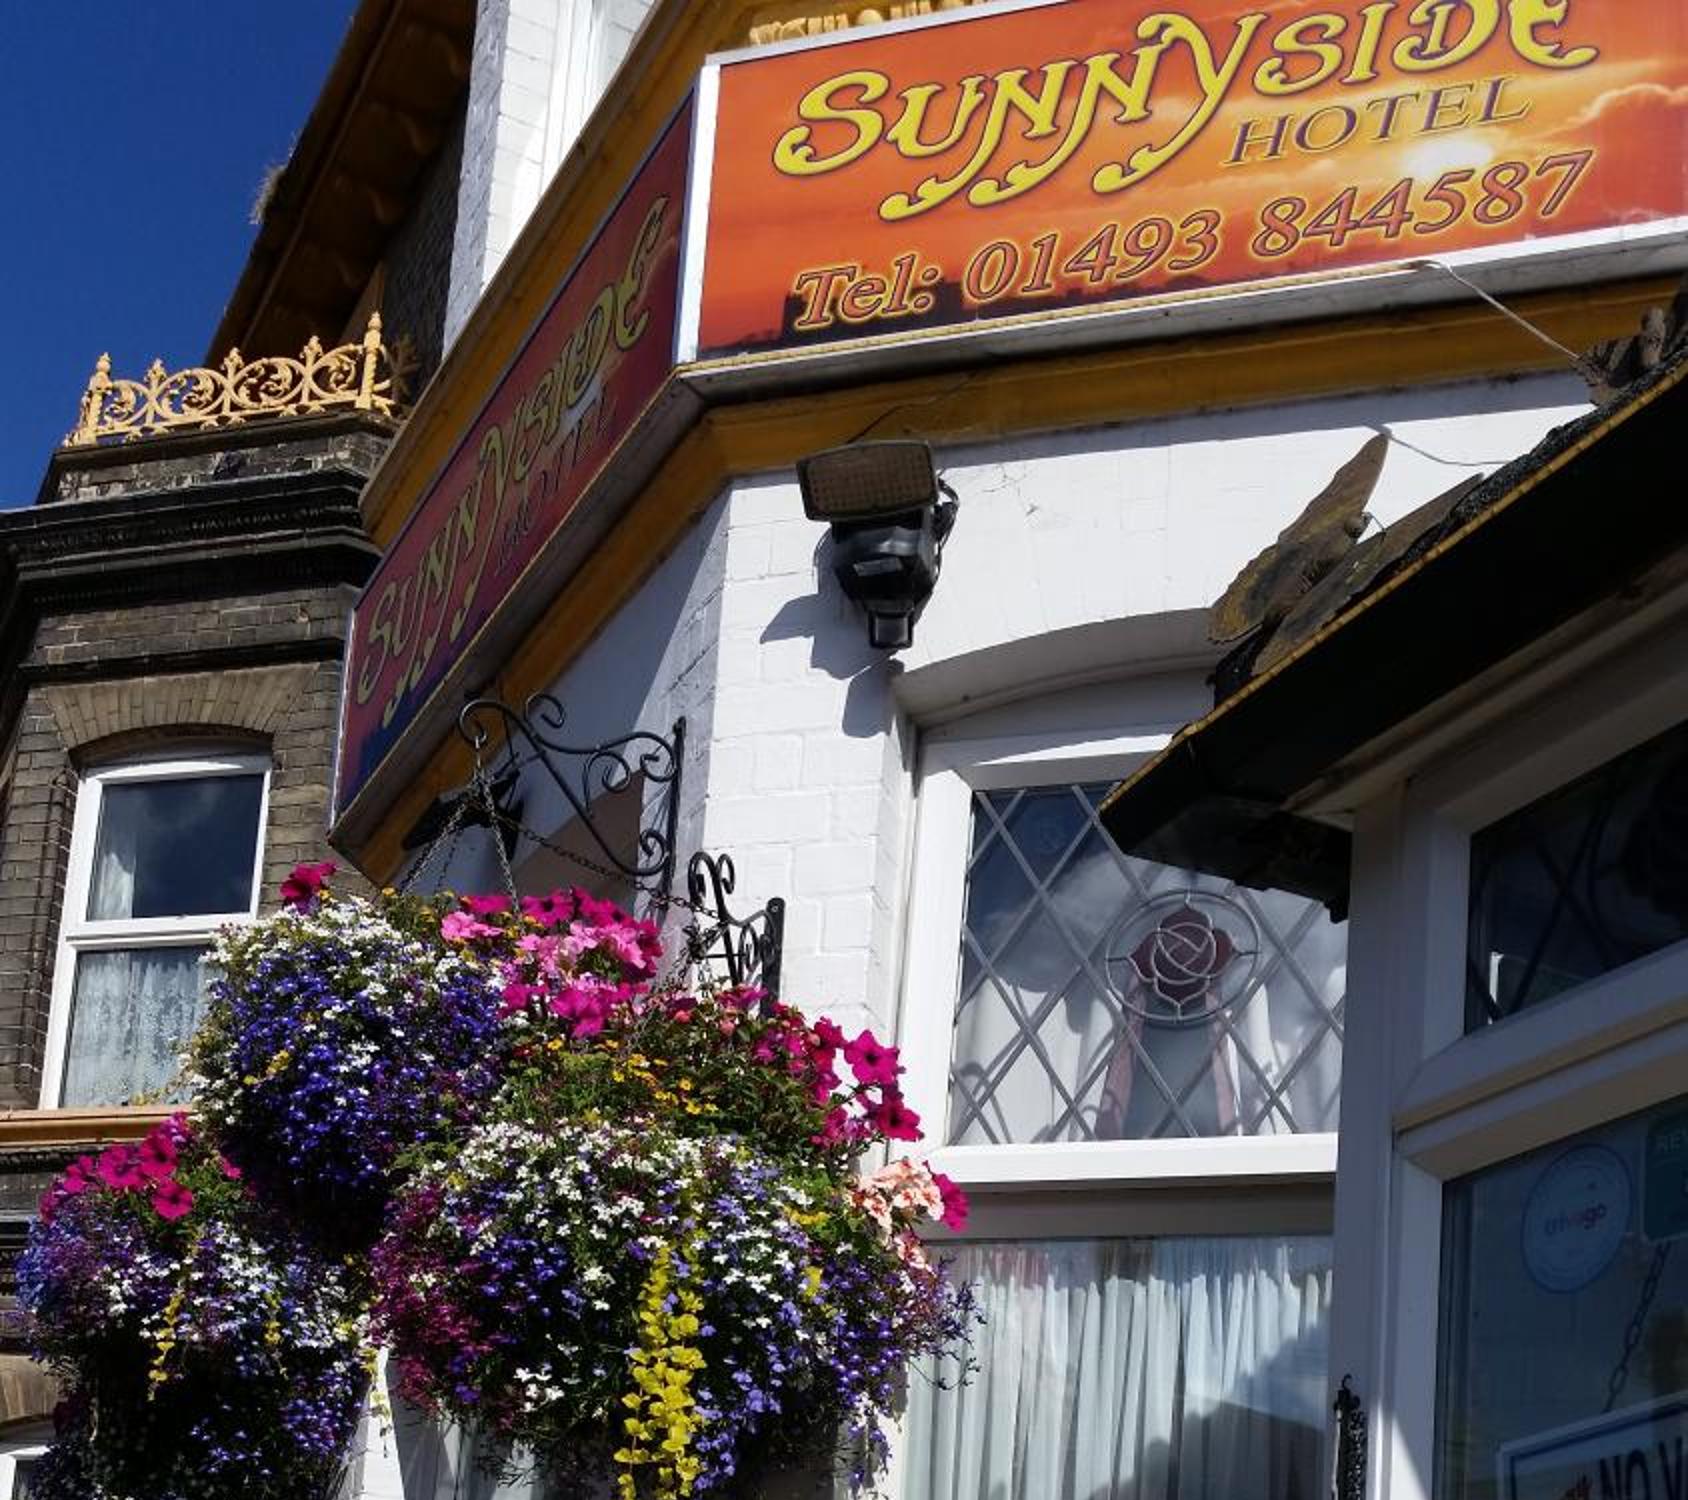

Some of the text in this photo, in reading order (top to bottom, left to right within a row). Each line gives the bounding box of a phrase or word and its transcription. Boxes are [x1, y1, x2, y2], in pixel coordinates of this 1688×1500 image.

[771, 0, 1600, 223] SUNNYSIDE
[1222, 72, 1534, 168] HOTEL
[795, 148, 1595, 331] Tel: 01493 844587
[357, 195, 667, 728] SUNNYSIDE
